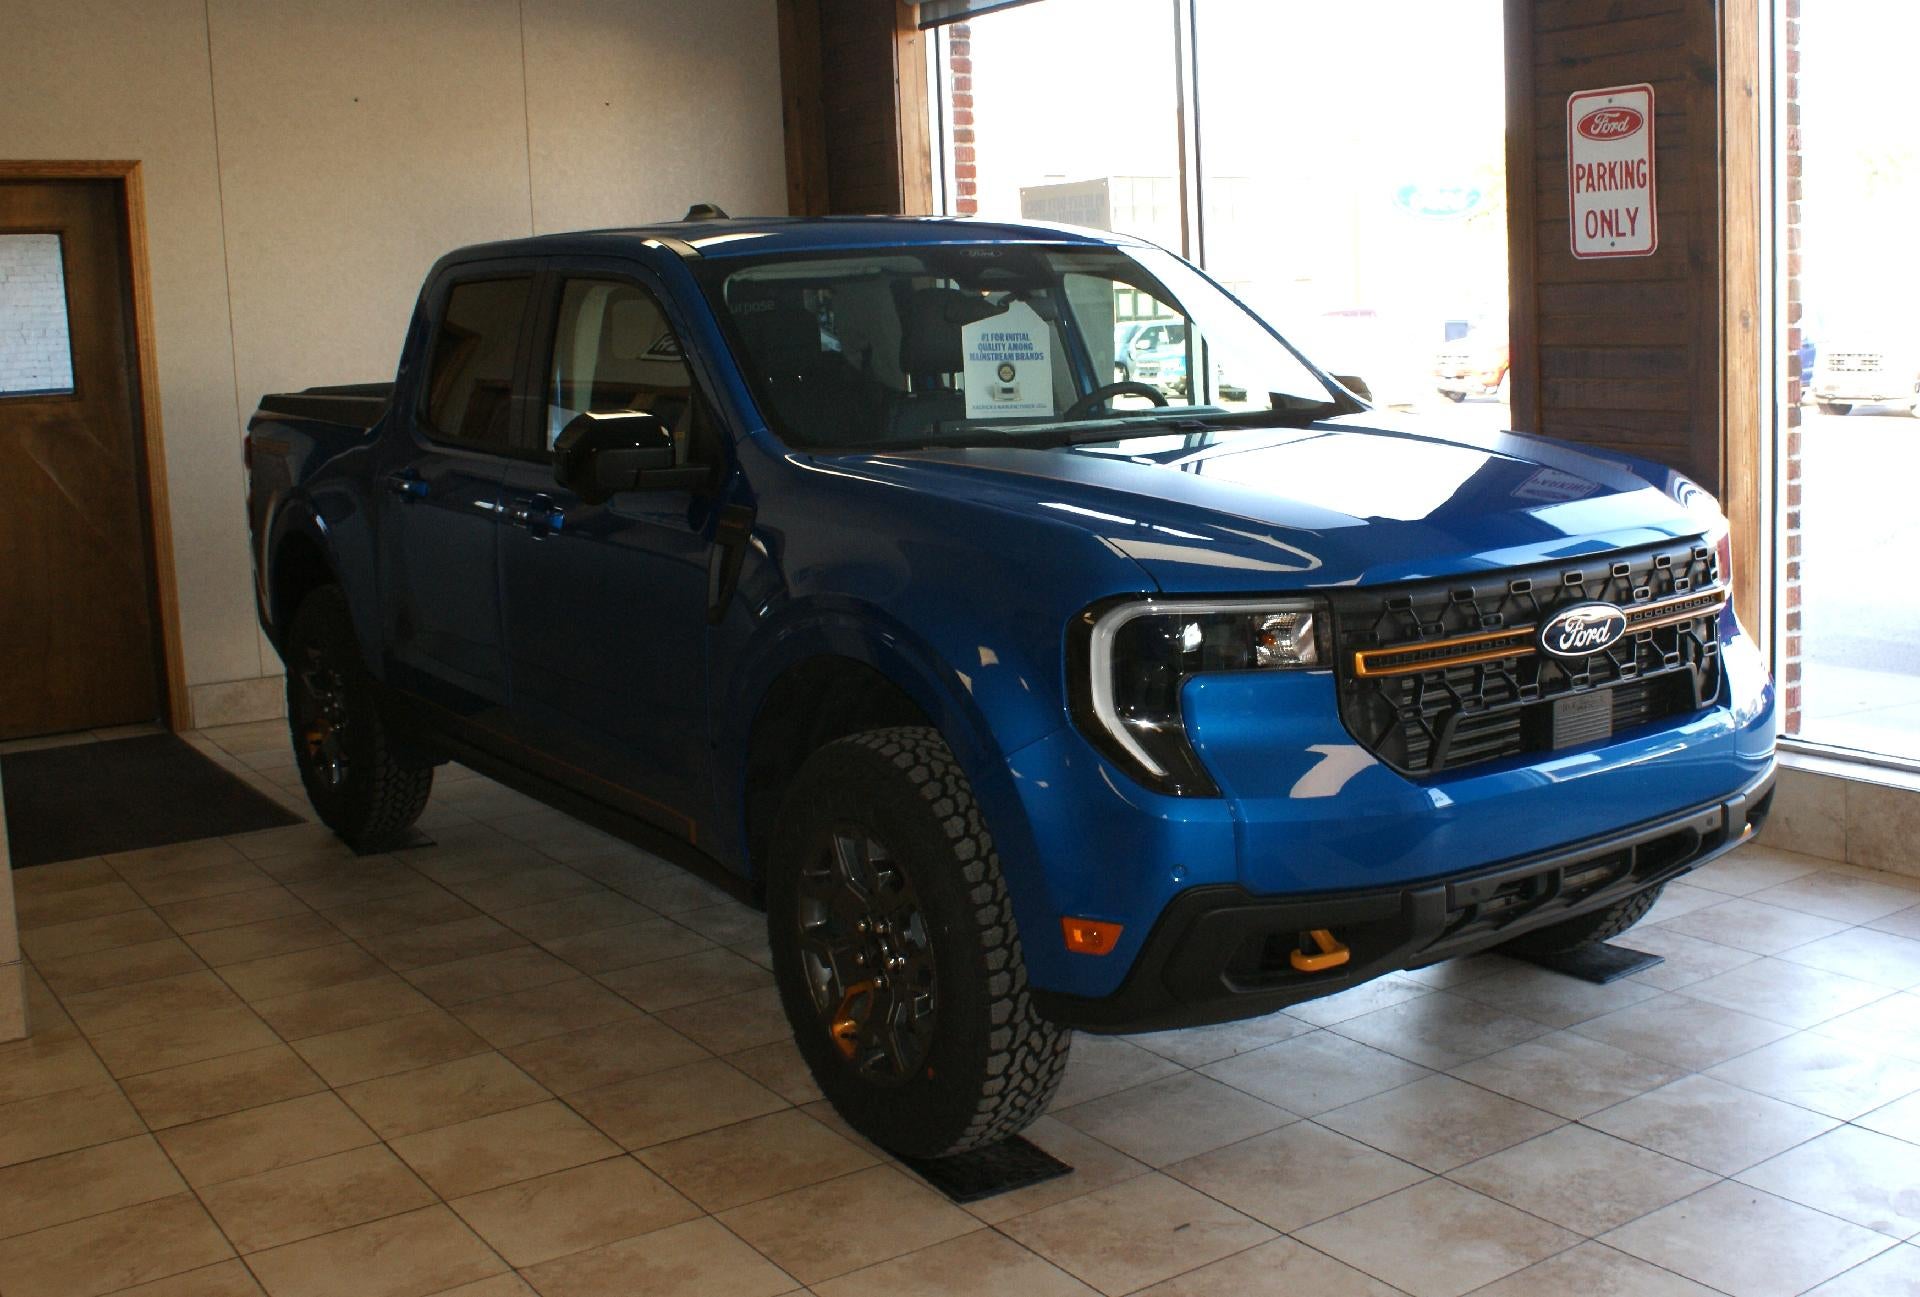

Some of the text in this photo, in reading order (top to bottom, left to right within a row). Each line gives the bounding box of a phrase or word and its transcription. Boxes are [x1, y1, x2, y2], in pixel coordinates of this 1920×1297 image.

[1590, 111, 1629, 136] Ford
[1575, 158, 1647, 194] PARKING
[1585, 206, 1639, 240] ONLY
[977, 343, 1034, 352] QUALITY AMONG
[991, 333, 1005, 342] FOR
[1005, 333, 1030, 342] INITIAL
[969, 352, 1045, 362] MAINSTREAM BRANDS
[1559, 613, 1611, 650] Ford
